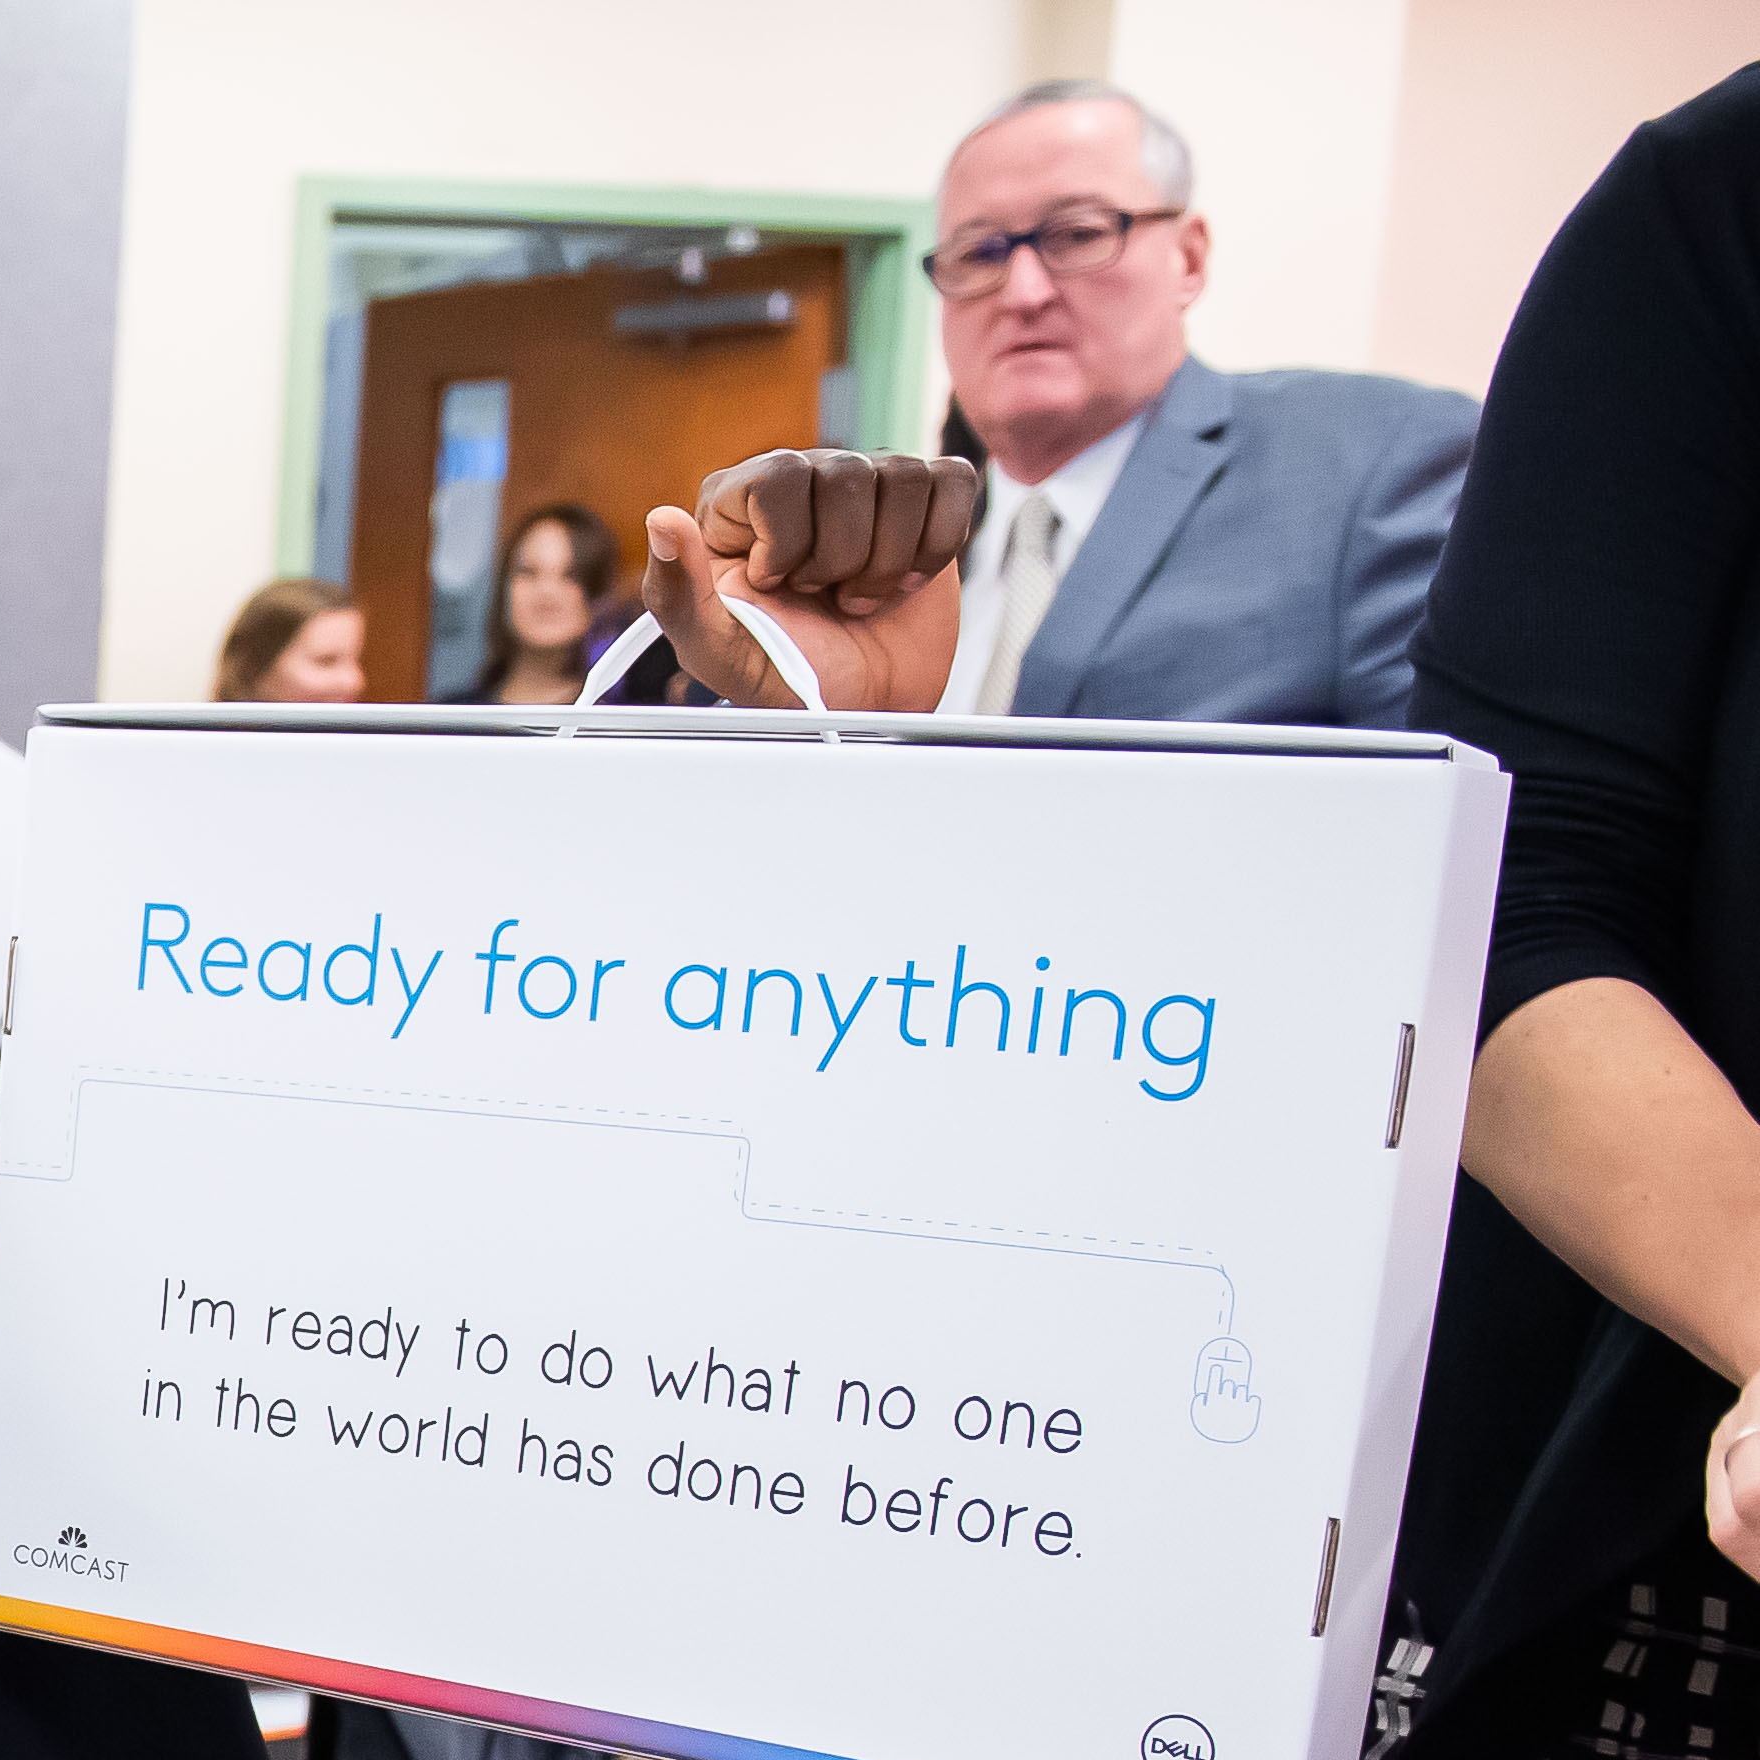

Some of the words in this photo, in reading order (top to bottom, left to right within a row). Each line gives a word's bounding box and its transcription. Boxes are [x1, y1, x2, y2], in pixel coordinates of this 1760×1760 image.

[138, 903, 443, 1039] Ready
[476, 919, 625, 1021] for
[665, 945, 1215, 1101] anything
[161, 1278, 235, 1340] I'm
[266, 1307, 420, 1377] ready
[456, 1319, 508, 1375] to
[541, 1330, 613, 1389] do
[647, 1347, 801, 1414] what
[837, 1380, 915, 1430] no
[954, 1396, 1082, 1453] one
[142, 1369, 183, 1421] in
[216, 1378, 296, 1437] the
[328, 1406, 489, 1467] world
[518, 1418, 613, 1486] has
[648, 1441, 804, 1514] done
[841, 1465, 1081, 1558] before.
[13, 1542, 129, 1582] COMCAST
